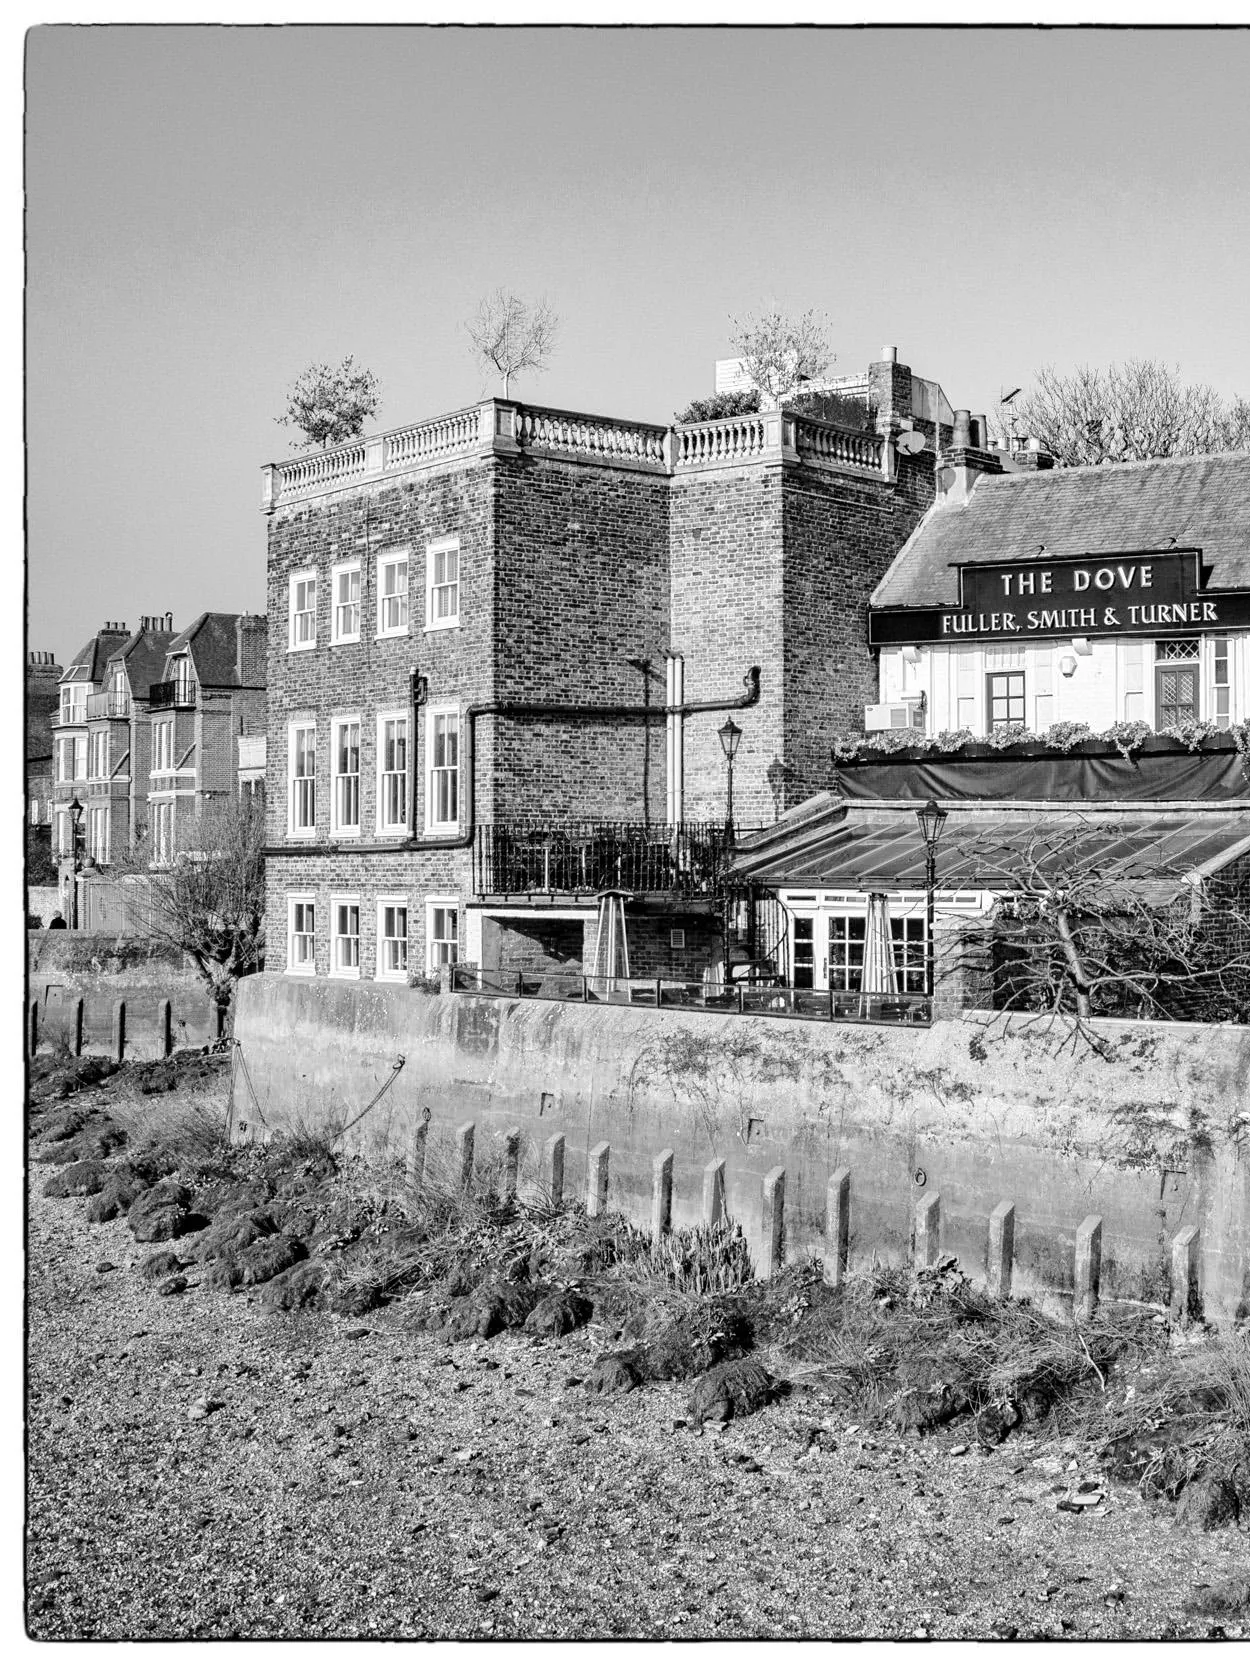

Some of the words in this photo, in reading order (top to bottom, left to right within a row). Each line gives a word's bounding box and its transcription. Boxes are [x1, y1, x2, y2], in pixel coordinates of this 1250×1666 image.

[1001, 571, 1053, 596] THE
[1073, 565, 1153, 592] DOVE
[942, 612, 1023, 634] FULLER,
[1027, 607, 1099, 630] SMITH
[1103, 606, 1121, 626] &
[1127, 601, 1219, 625] TURNER
